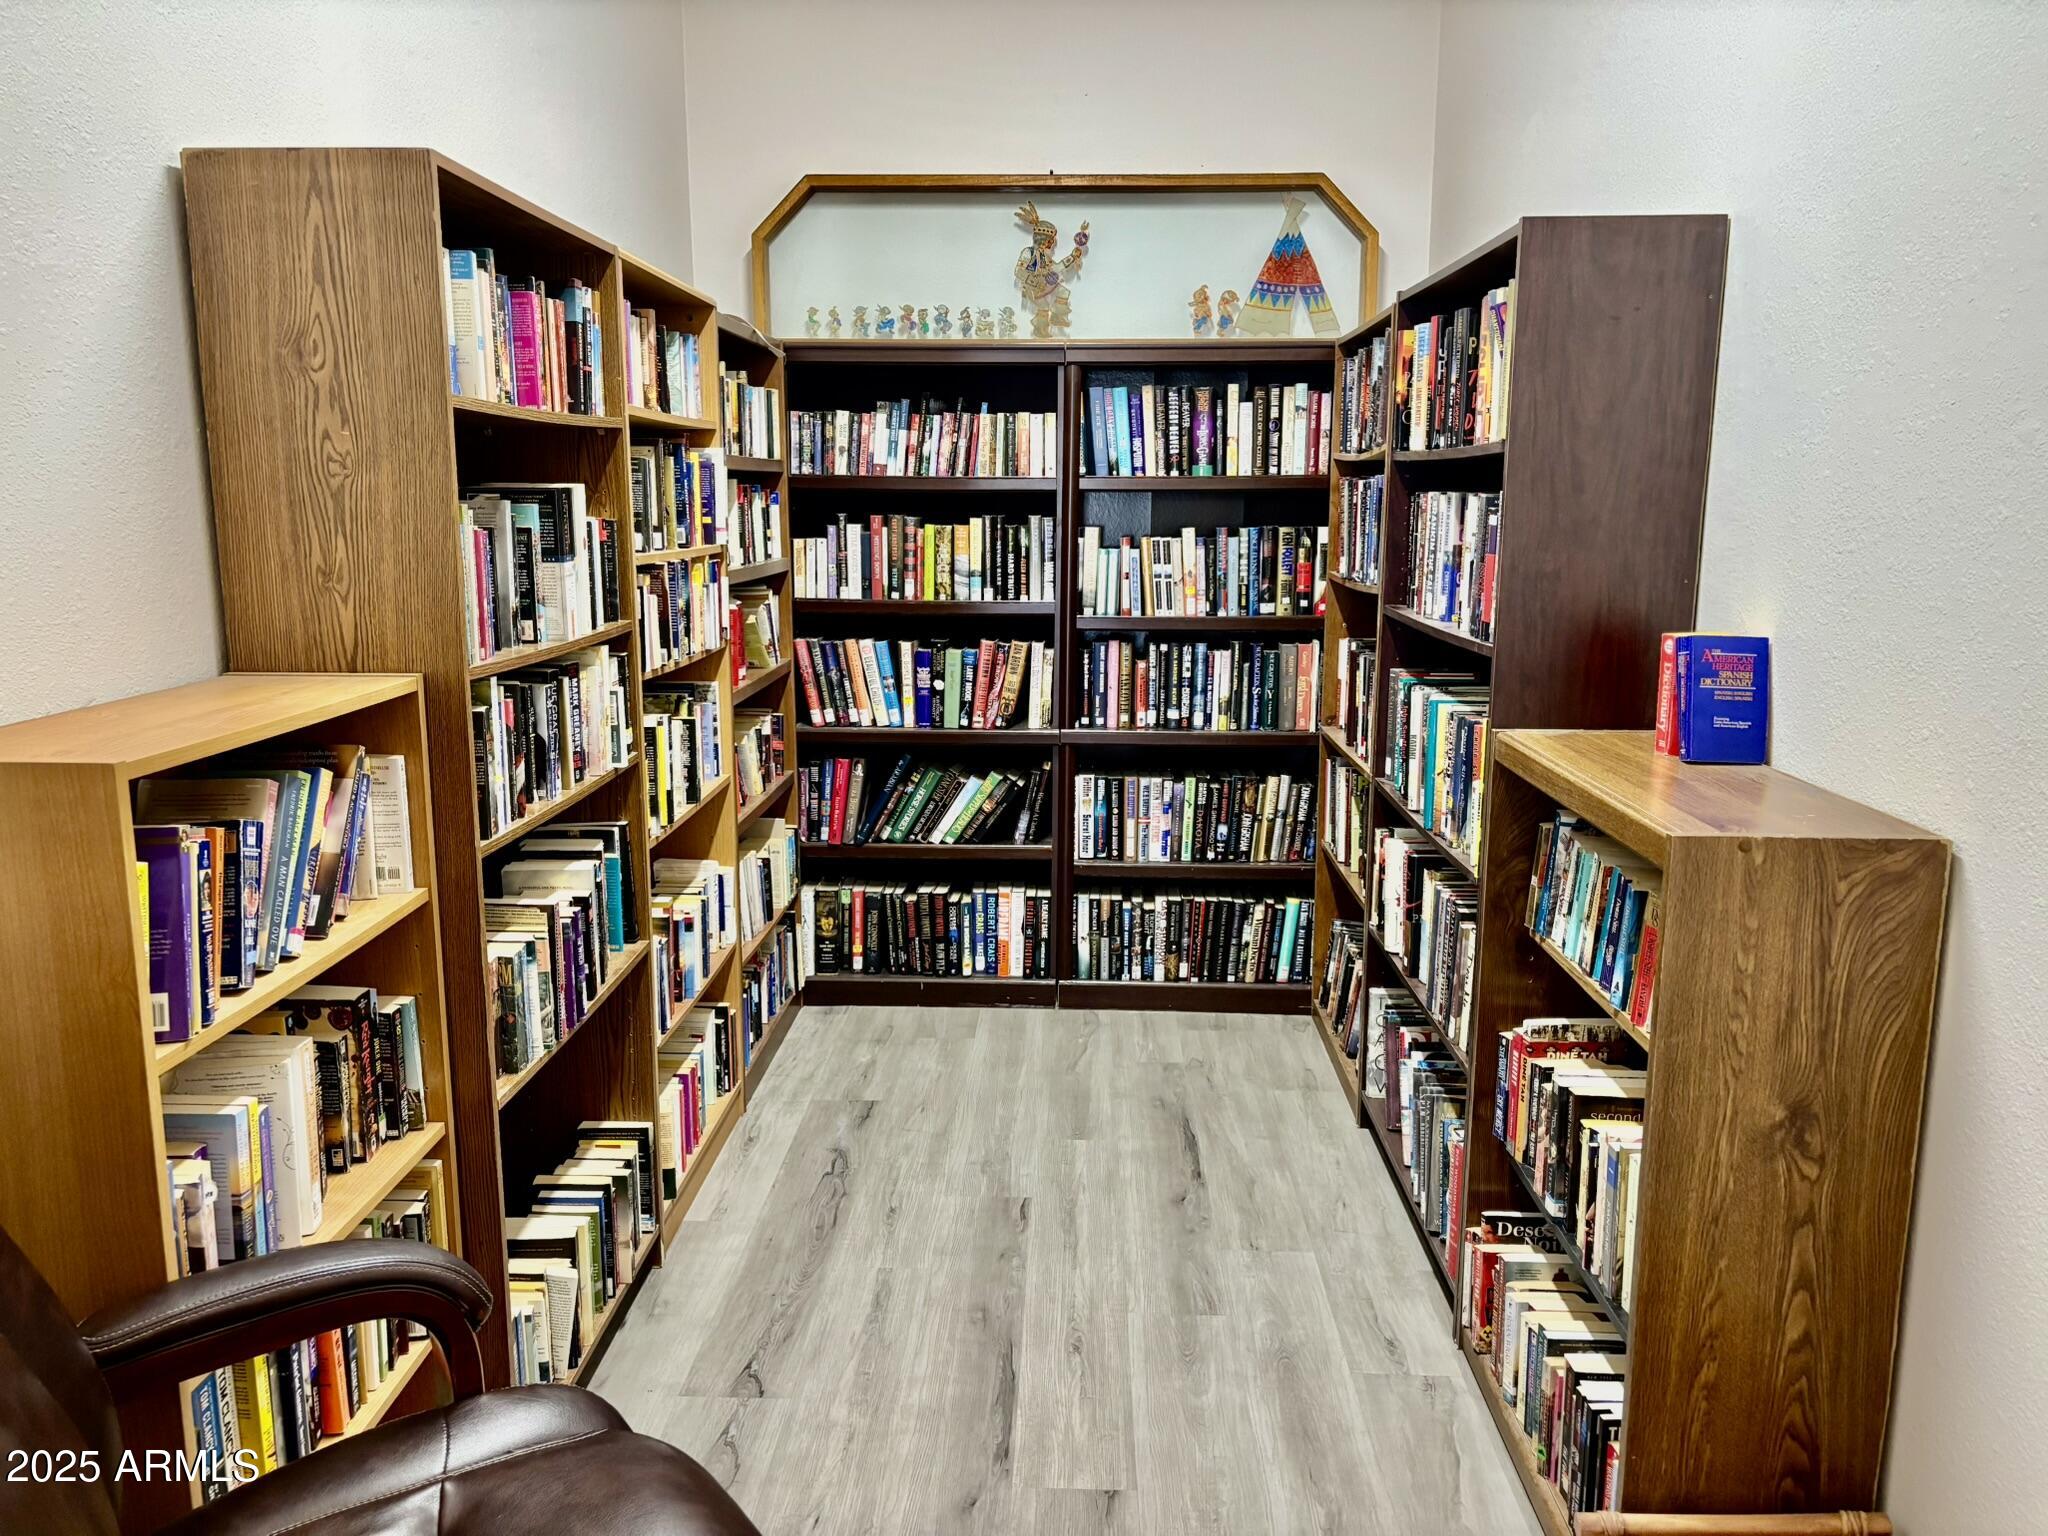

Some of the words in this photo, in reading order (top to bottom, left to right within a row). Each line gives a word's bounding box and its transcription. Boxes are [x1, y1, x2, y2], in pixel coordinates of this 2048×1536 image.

[1169, 391, 1179, 423] JEFFERY
[1182, 402, 1190, 428] DEAVER
[1169, 426, 1179, 454] DEAVER
[1250, 529, 1258, 550] VINCE
[1282, 532, 1294, 547] KEN
[1250, 551, 1258, 576] FLYNN
[1282, 547, 1294, 576] FOLLETT
[1009, 655, 1021, 675] BROWN
[1702, 649, 1754, 664] AMERICAN
[1712, 663, 1753, 671] HERITAGE
[1700, 678, 1752, 687] DICTIONARY
[1719, 671, 1753, 680] SPANISH
[571, 677, 580, 708] MARK
[1657, 662, 1673, 732] Dictionary
[573, 708, 582, 752] GREANEY
[851, 779, 860, 797] LAURA
[910, 787, 926, 808] HORSE
[1081, 777, 1092, 797] Griffin
[1300, 786, 1311, 799] JOHN
[288, 790, 296, 816] FREDRIK
[849, 797, 857, 815] BUSH
[1034, 792, 1045, 812] Richard
[1297, 799, 1308, 821] GRISHAM
[897, 807, 916, 831] STORIES
[1081, 814, 1092, 834] Secret
[1195, 810, 1203, 849] DAKOTA
[1239, 813, 1252, 828] JOHN
[284, 817, 294, 848] BACKMAN
[1081, 835, 1092, 853] Honor
[1239, 828, 1252, 851] GRISHAM
[278, 865, 287, 886] MAN
[273, 889, 285, 923] CALLED
[987, 897, 995, 928] ROBERT
[1041, 903, 1049, 923] DEADLY
[975, 912, 984, 934] CRAIS
[1041, 924, 1049, 939] GAME
[270, 926, 279, 945] OVE
[987, 938, 995, 962] CRAIS
[360, 1020, 371, 1047] Red
[361, 1048, 375, 1095] Knight
[1497, 1046, 1506, 1084] STEWART
[1496, 1108, 1505, 1134] MERCY
[218, 1370, 228, 1400] TOM
[199, 1386, 210, 1410] TOM
[222, 1401, 234, 1459] CLANCY
